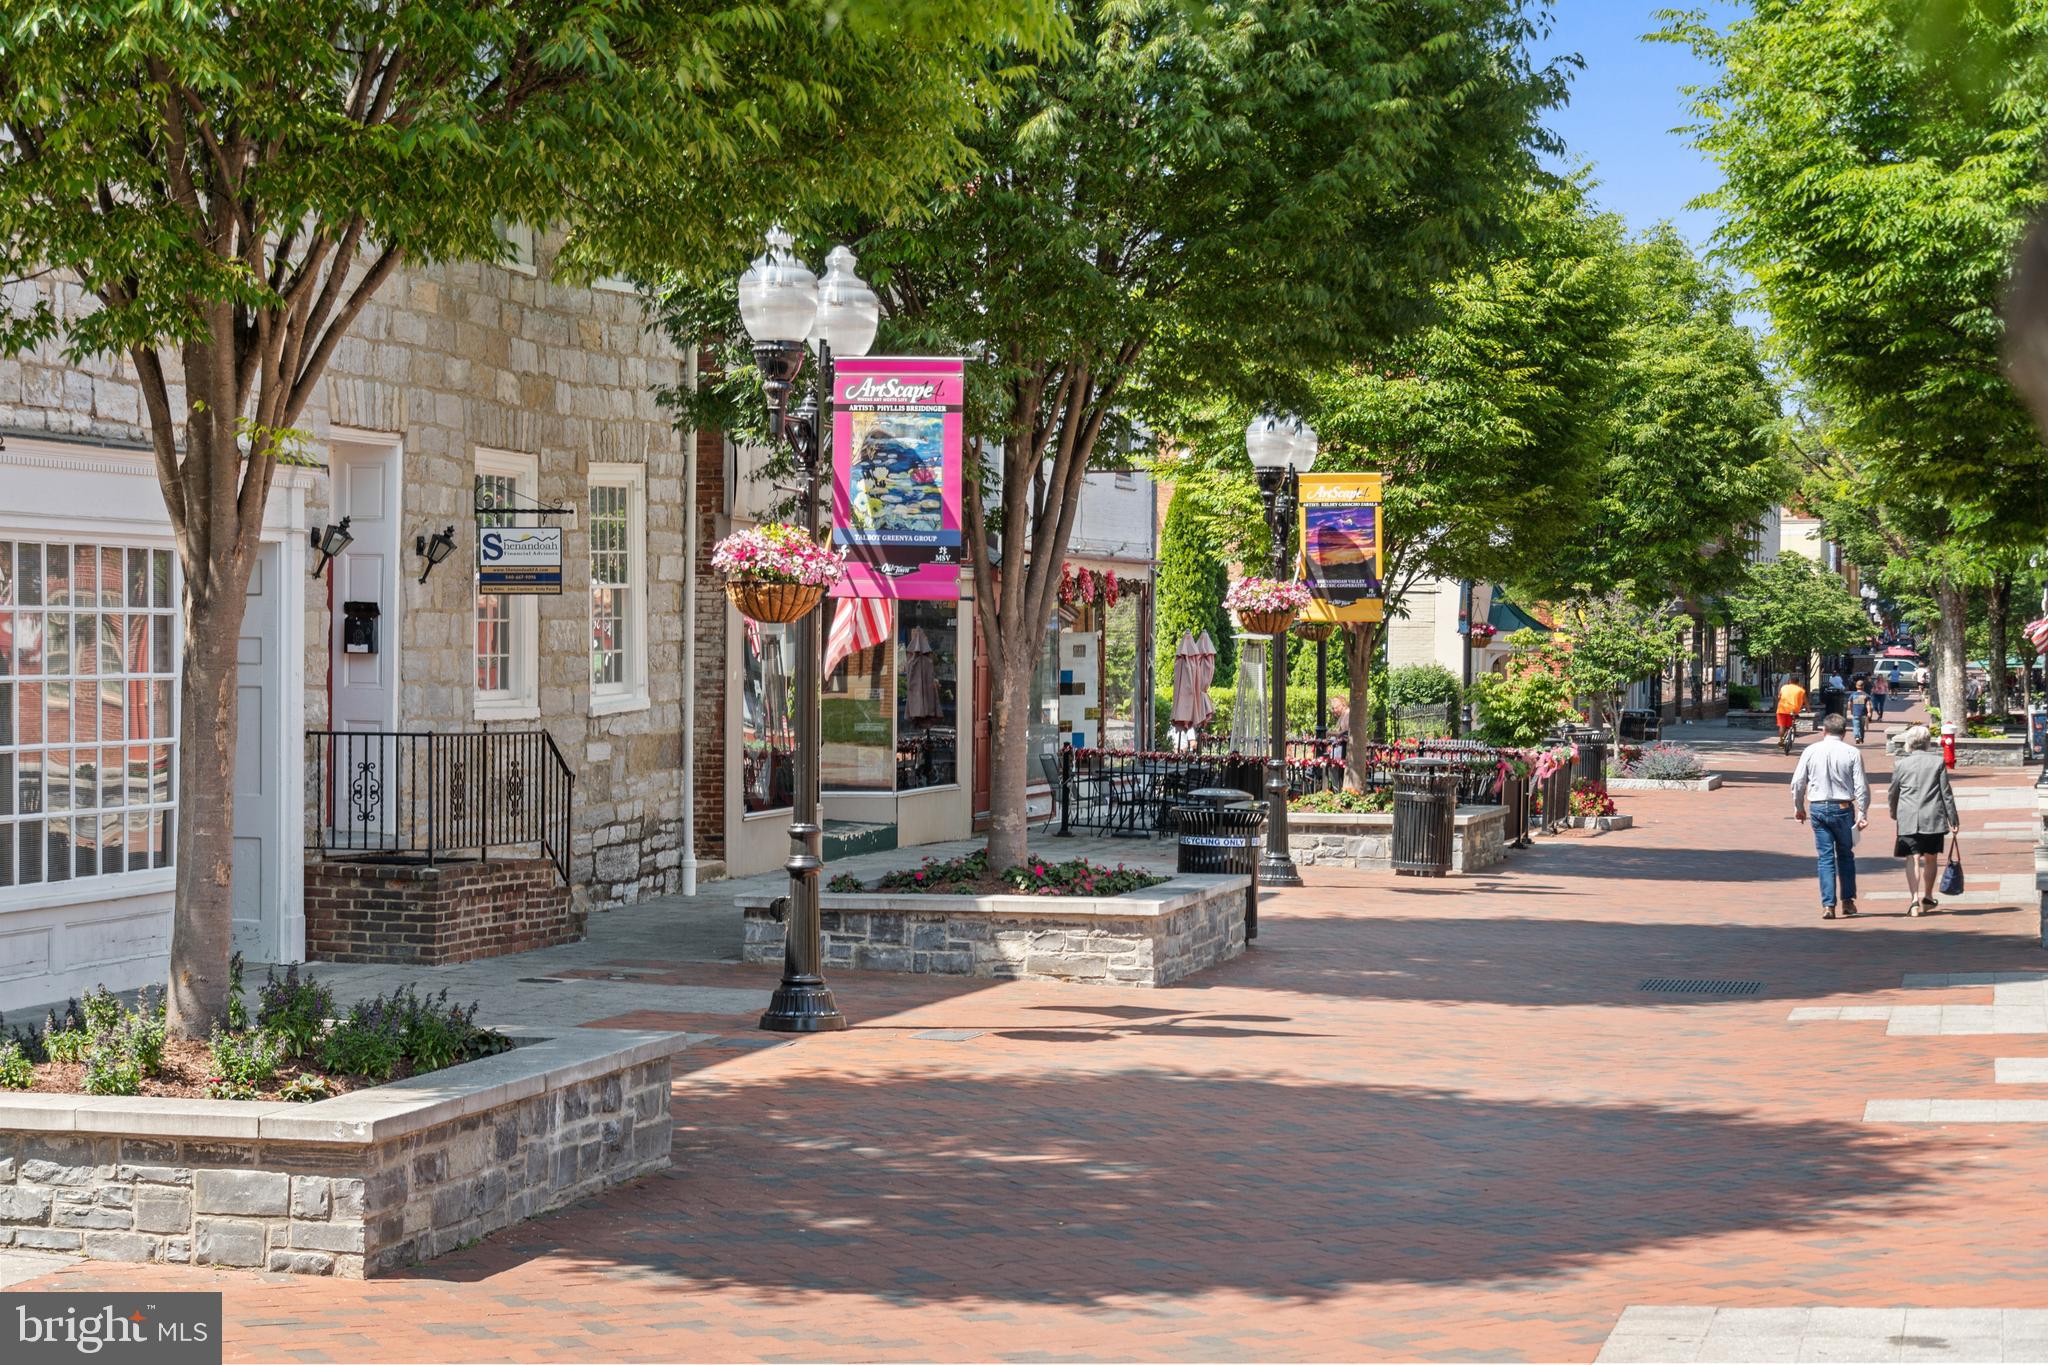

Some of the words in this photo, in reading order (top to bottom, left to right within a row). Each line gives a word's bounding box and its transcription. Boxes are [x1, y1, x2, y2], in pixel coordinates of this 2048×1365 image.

[845, 377, 934, 403] ArtScape
[848, 404, 875, 412] ARTIST:
[482, 533, 558, 560] Shenandoah
[935, 554, 951, 562] MSV
[1223, 838, 1245, 846] ONLY
